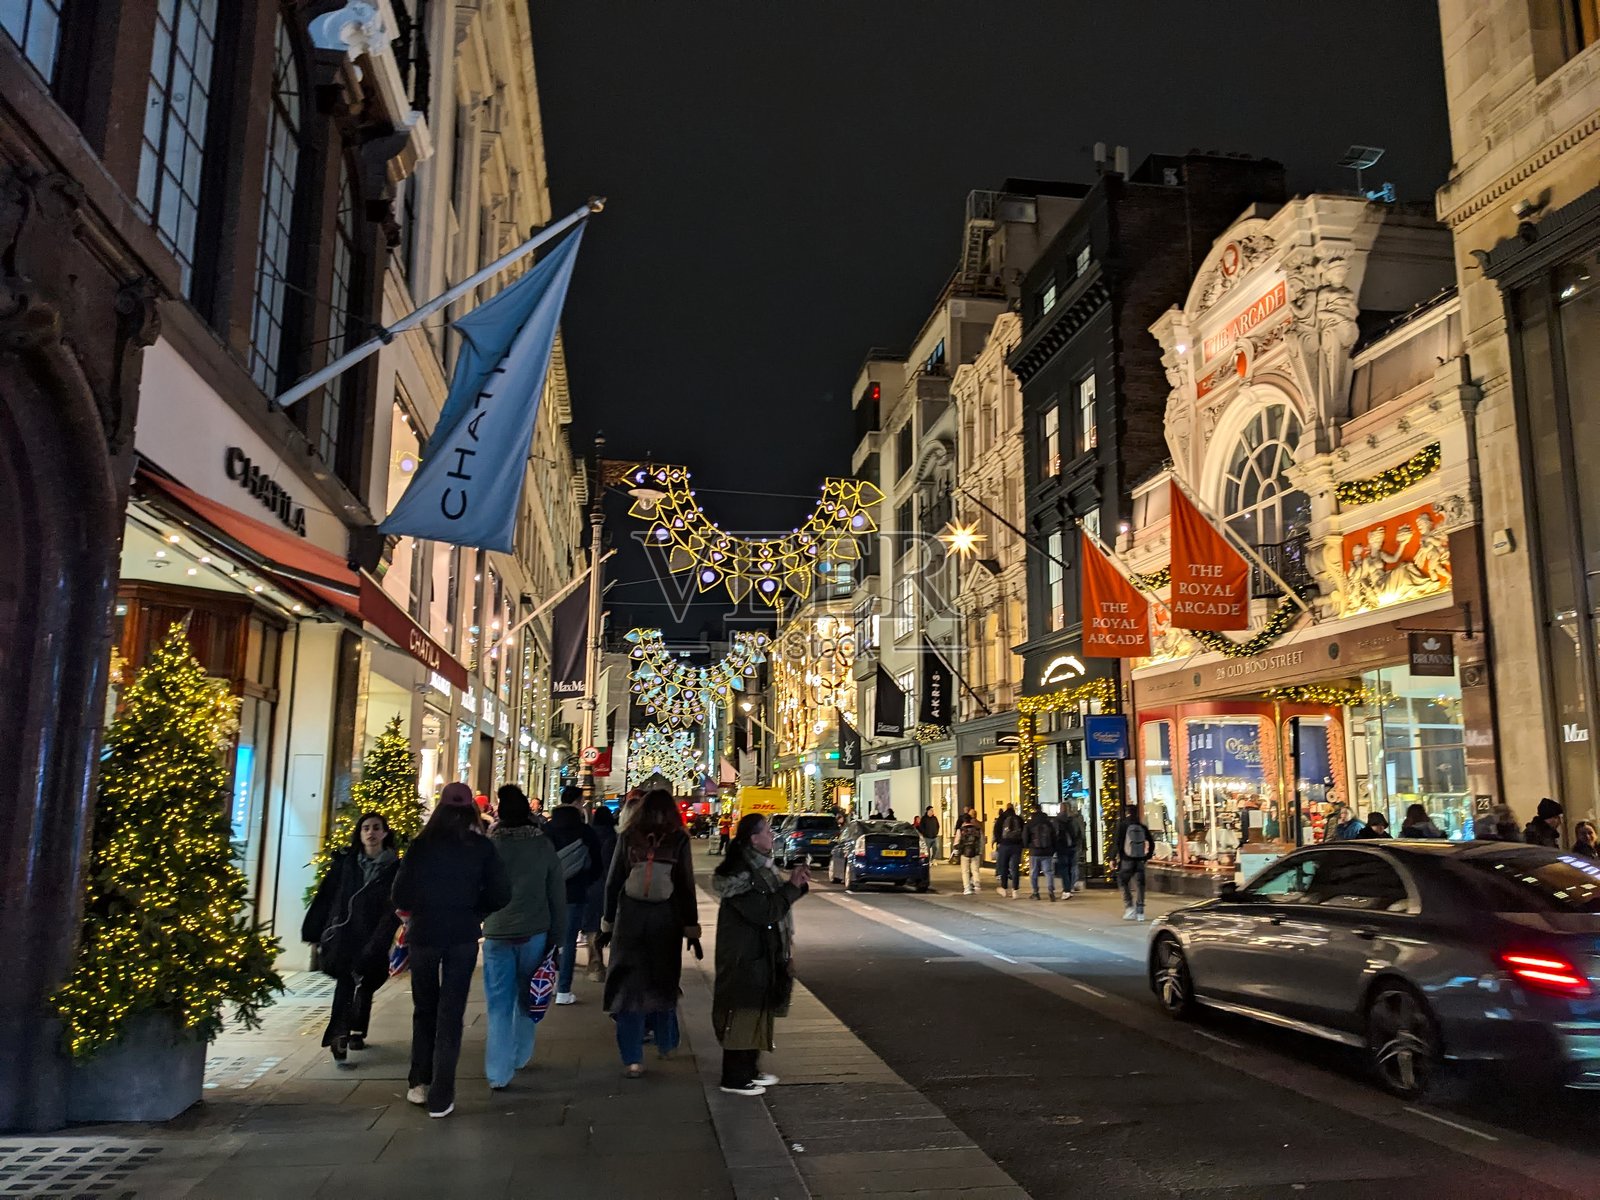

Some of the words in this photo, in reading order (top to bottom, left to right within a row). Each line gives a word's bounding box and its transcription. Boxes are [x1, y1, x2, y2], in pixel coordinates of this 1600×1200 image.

[1232, 285, 1284, 339] ARCADE
[224, 446, 306, 537] CHATILA
[1188, 564, 1223, 578] THE
[1179, 582, 1235, 597] ROYAL
[1100, 602, 1128, 613] THE
[1174, 601, 1240, 616] ARCADE
[1092, 618, 1139, 630] ROYAL
[1087, 633, 1145, 645] ARCADE
[409, 628, 440, 670] CHATILA
[1227, 663, 1243, 677] OLD
[1270, 650, 1304, 669] STREET
[1412, 653, 1453, 665] BROWNS
[585, 751, 597, 759] 20
[1476, 798, 1490, 810] 23
